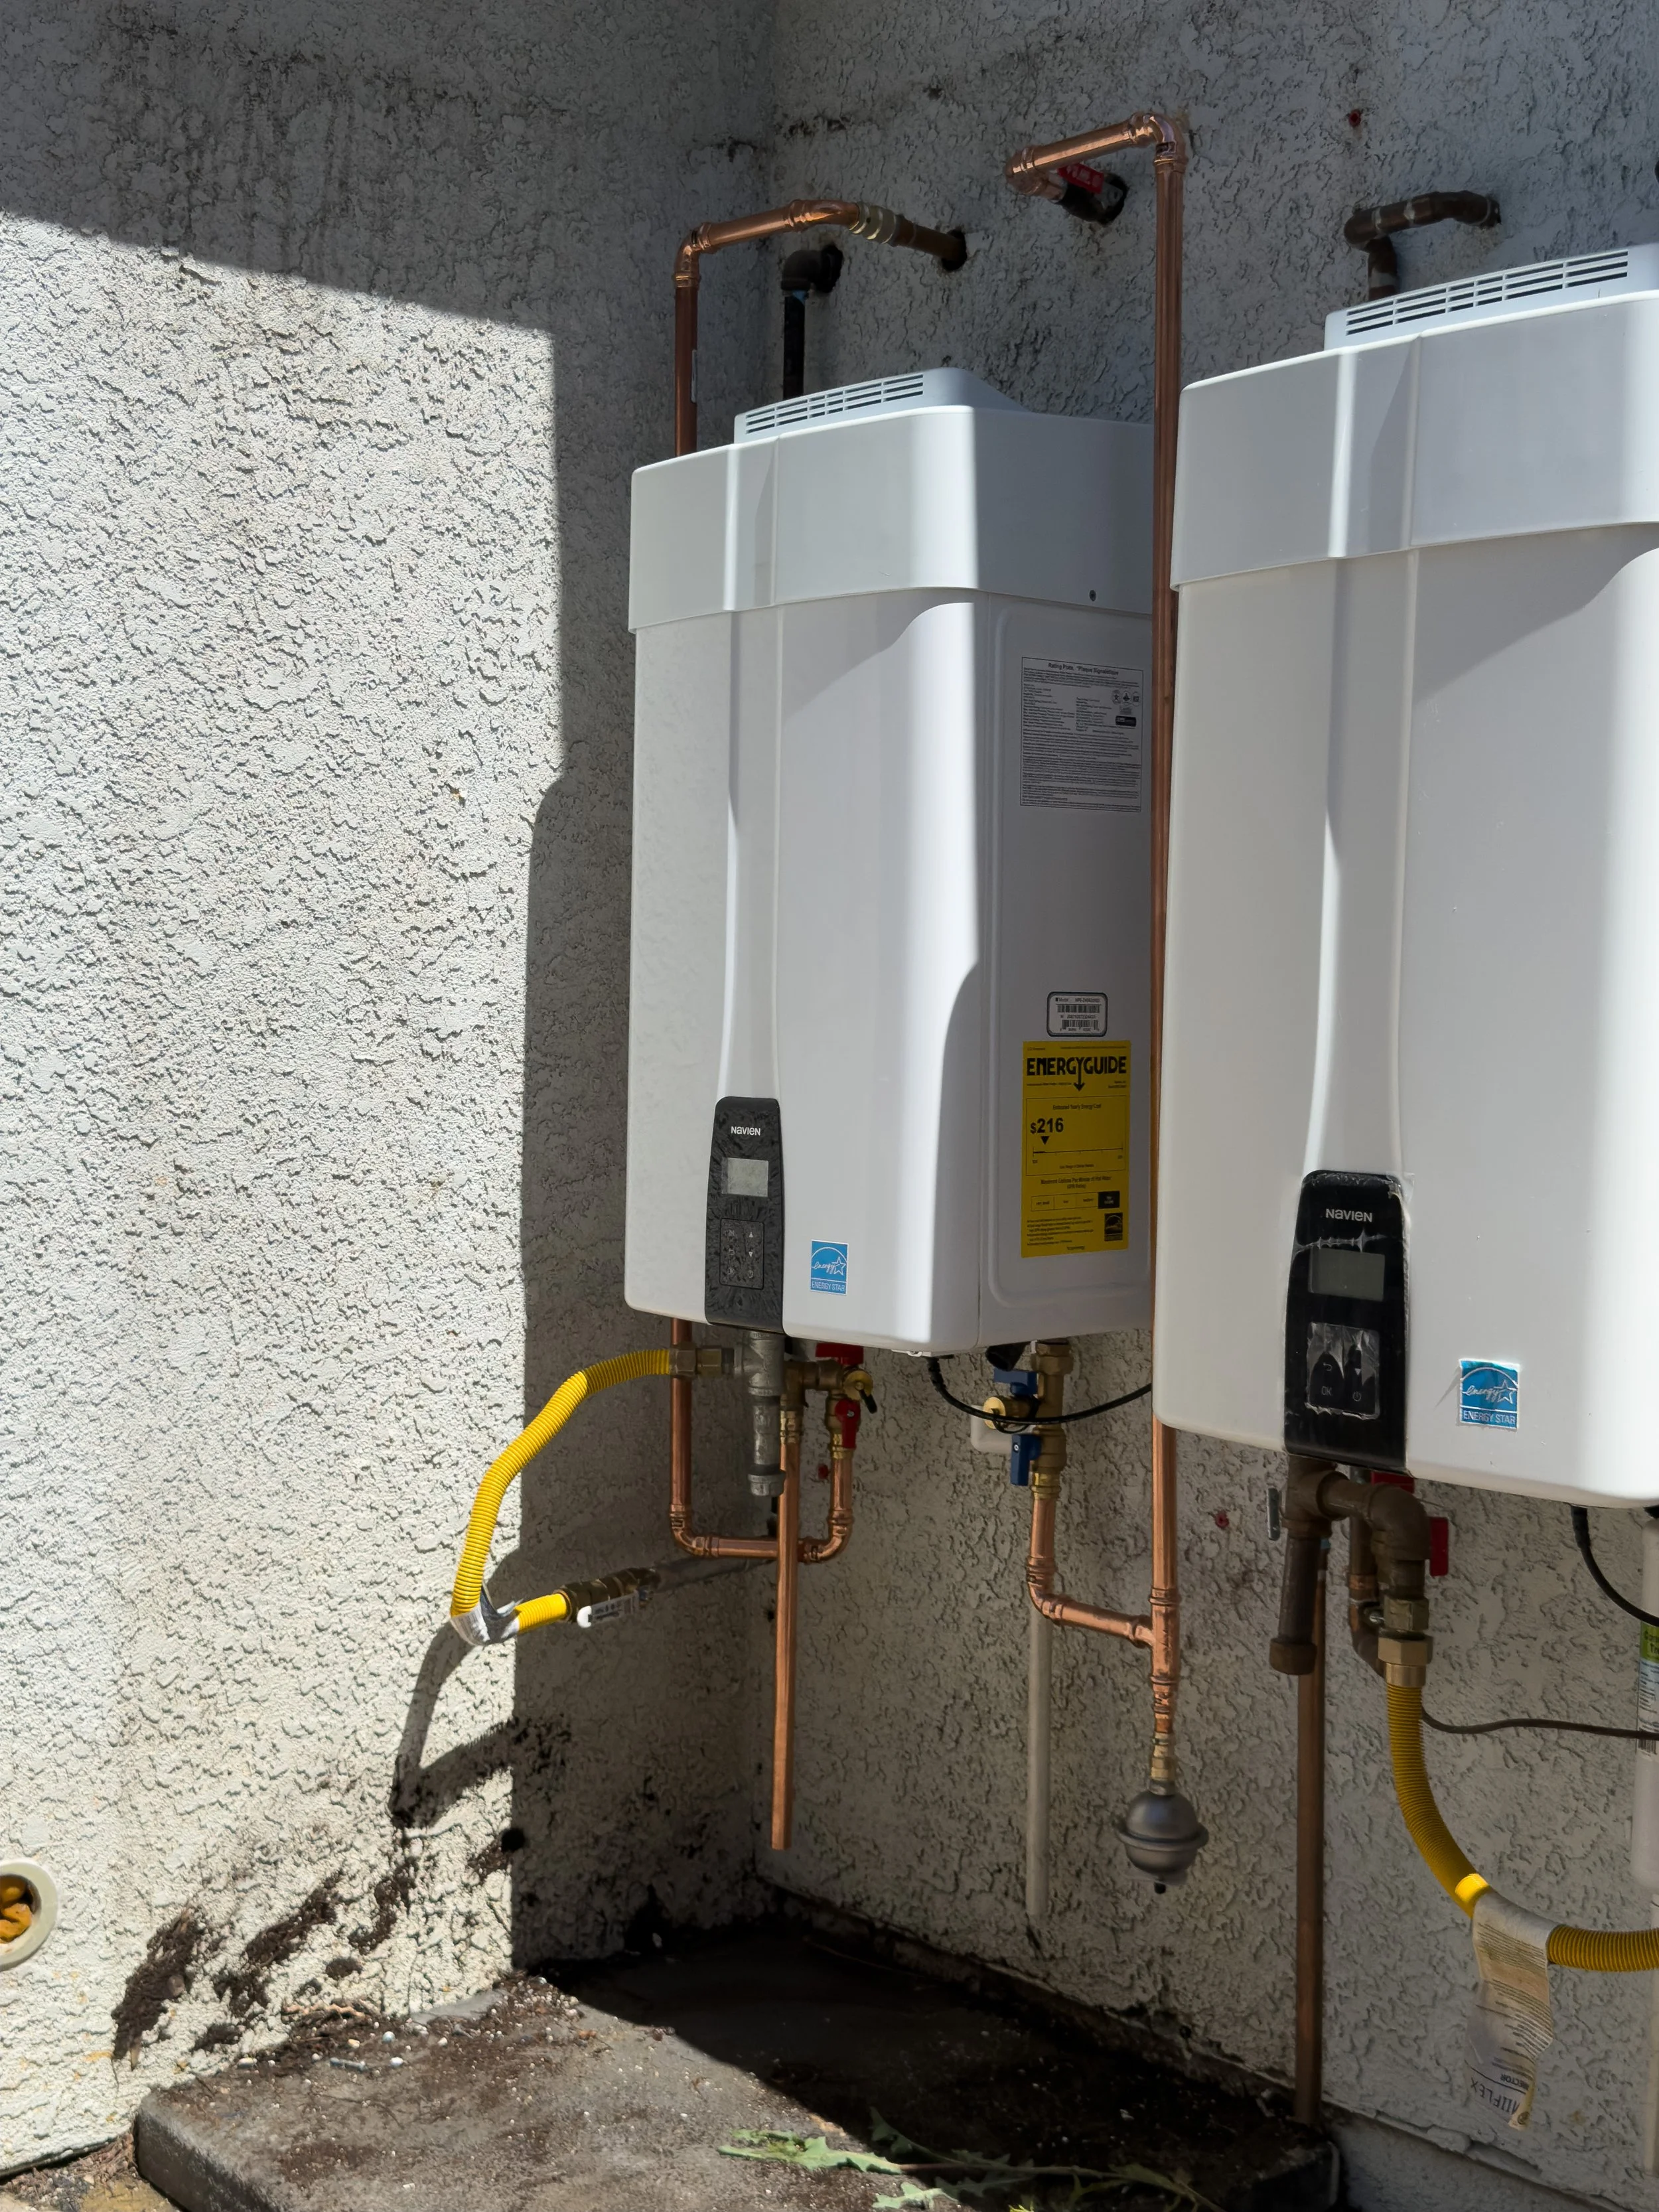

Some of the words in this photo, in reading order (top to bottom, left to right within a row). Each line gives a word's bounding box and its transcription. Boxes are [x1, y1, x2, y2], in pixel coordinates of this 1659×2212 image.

[1027, 1056, 1127, 1076] ENERGYGUIDE
[1030, 1117, 1064, 1134] $216
[812, 1281, 831, 1290] ENERGY
[831, 1284, 845, 1292] STAR
[1321, 1386, 1333, 1396] OK
[1463, 1410, 1494, 1422] ENERGY
[1495, 1414, 1516, 1424] STAR
